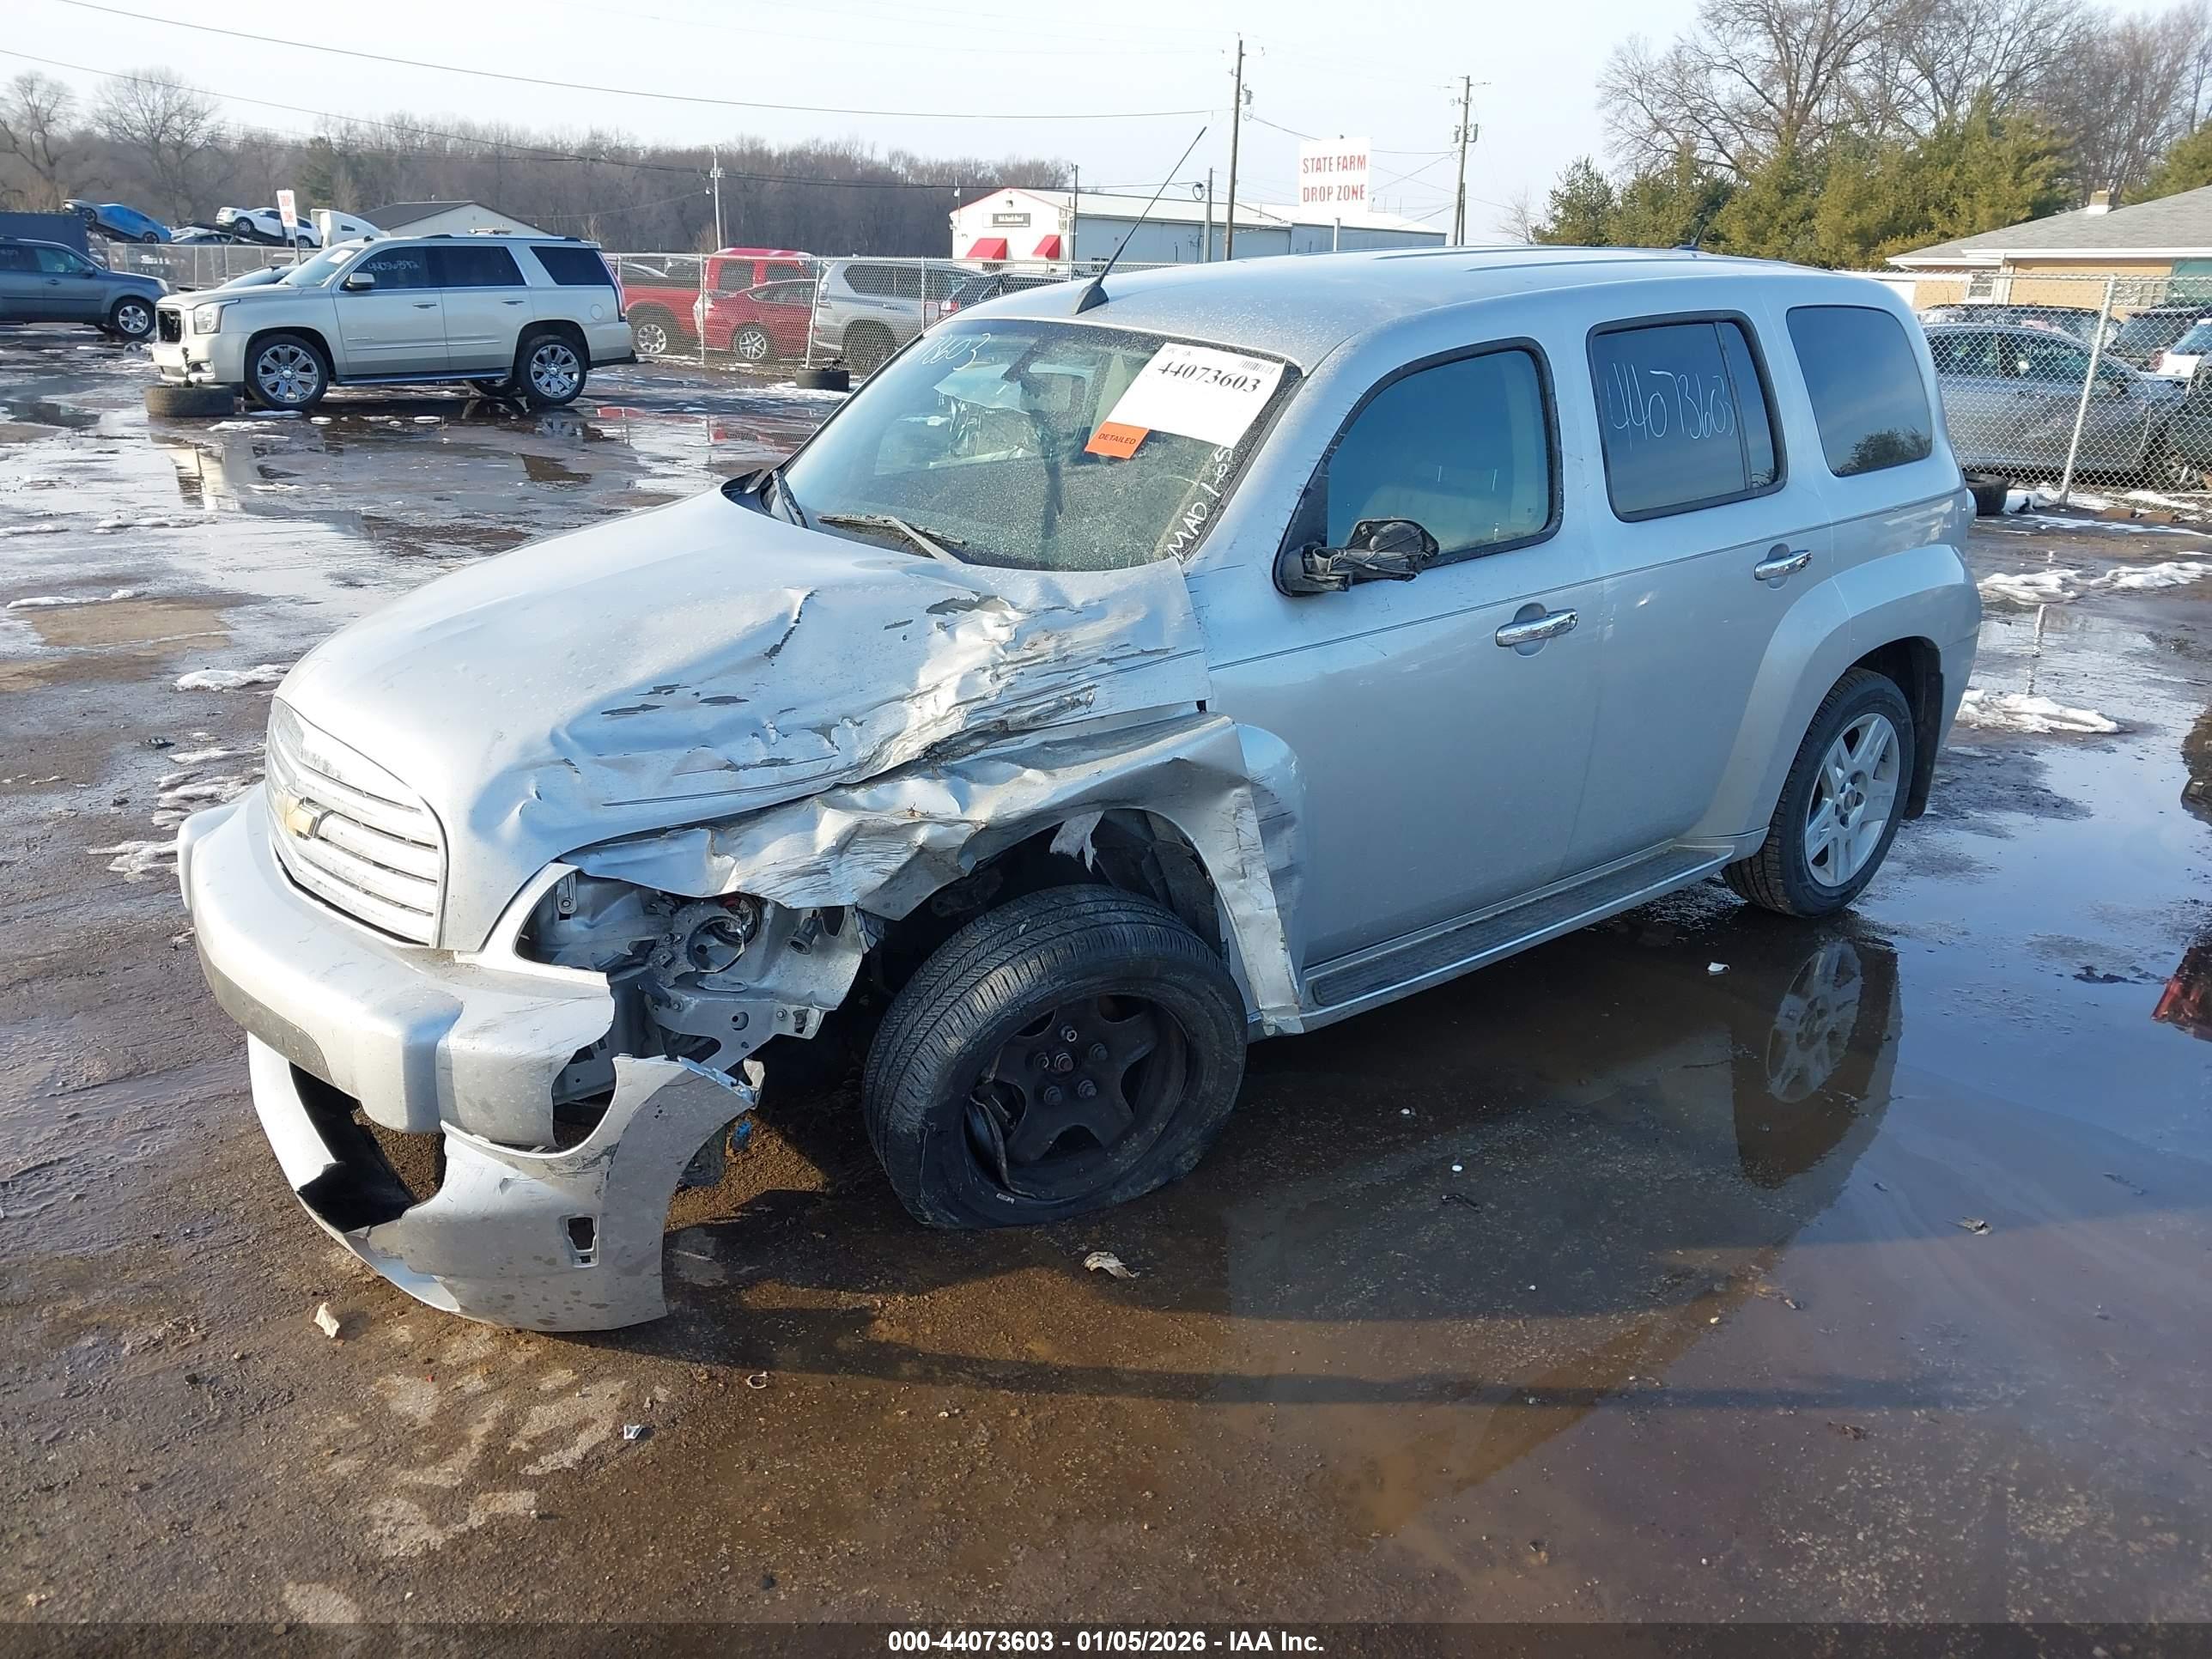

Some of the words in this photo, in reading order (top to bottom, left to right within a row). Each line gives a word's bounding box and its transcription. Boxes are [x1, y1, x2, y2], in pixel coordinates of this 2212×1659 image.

[1303, 156, 1334, 173] STATE
[1337, 155, 1366, 172] FARM
[1303, 185, 1334, 203] DROP
[1337, 184, 1365, 201] ZONE
[1157, 360, 1262, 394] 44073603
[1606, 362, 1735, 450] 44073603
[1098, 432, 1137, 446] DETAILED
[1167, 501, 1208, 563] MAD
